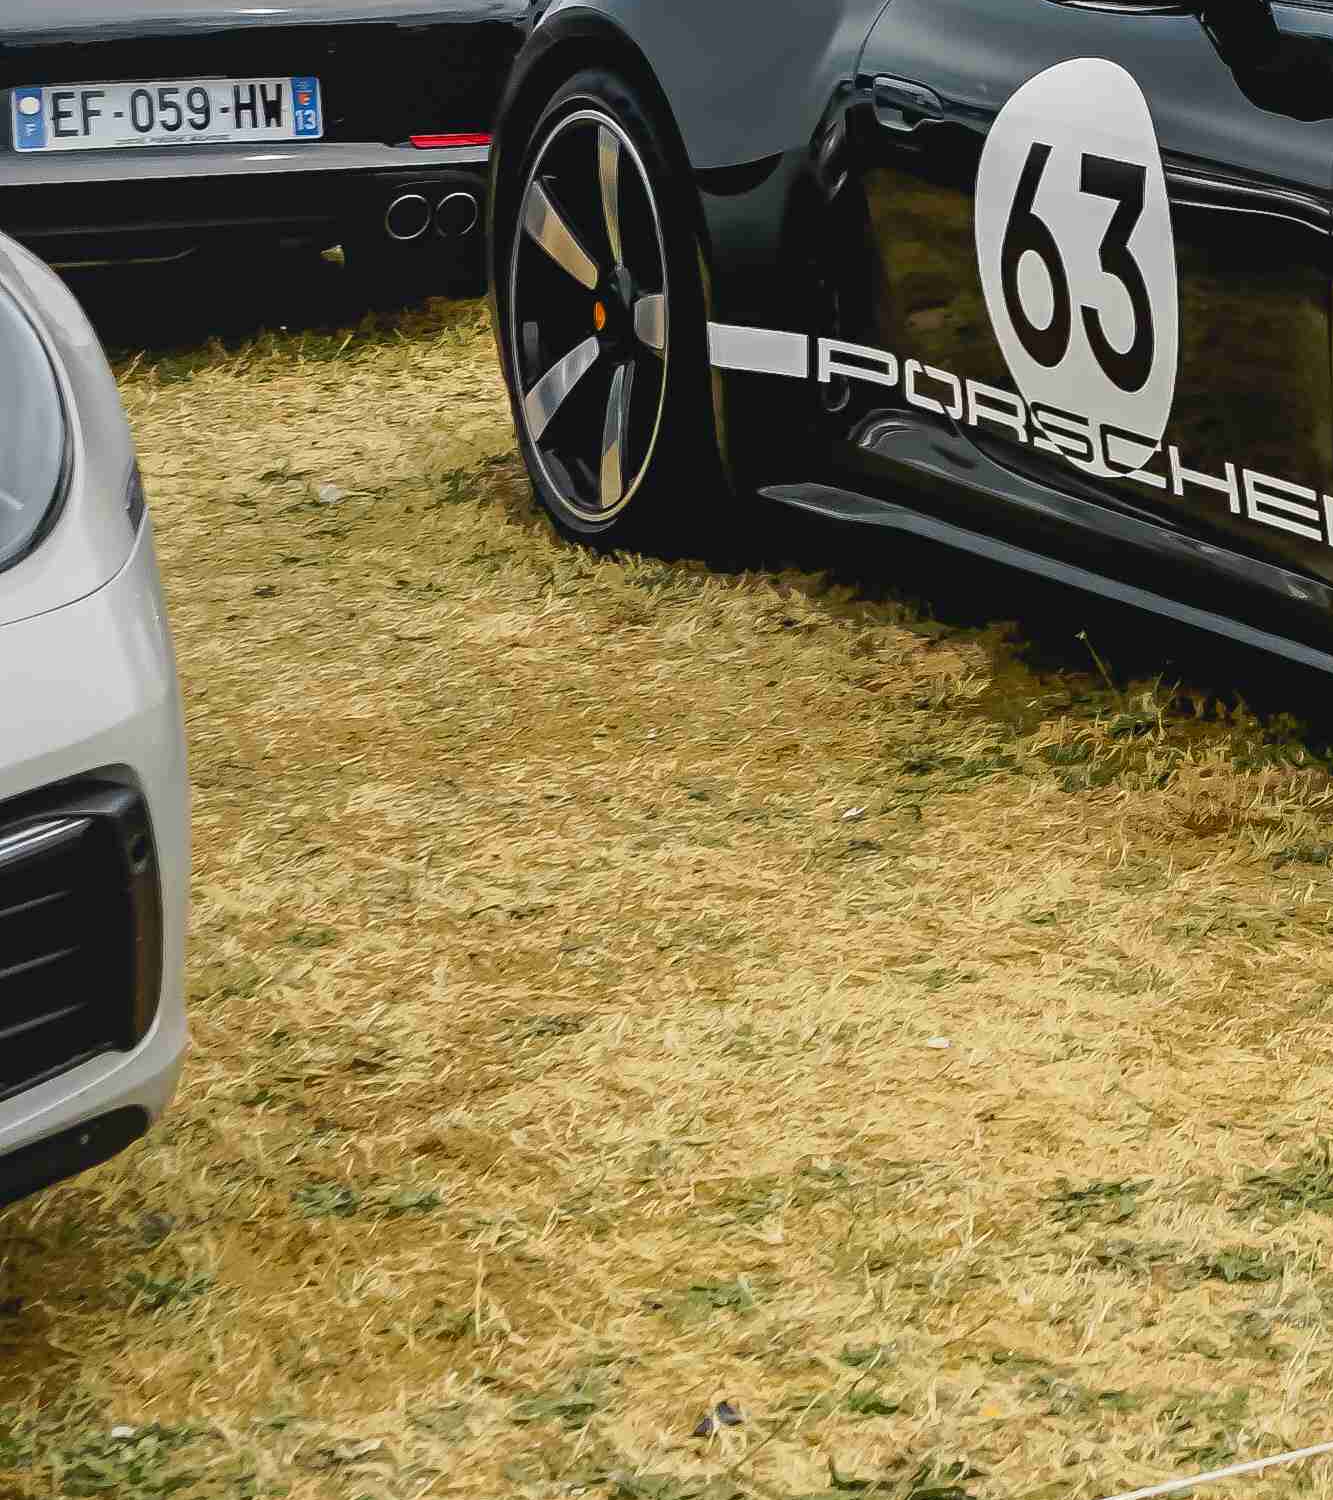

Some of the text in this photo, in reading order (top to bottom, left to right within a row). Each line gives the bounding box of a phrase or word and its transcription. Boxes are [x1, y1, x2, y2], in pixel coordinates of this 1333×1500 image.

[51, 83, 283, 138] EF-059-HW
[295, 109, 316, 130] 13
[1000, 140, 1155, 394] 63
[817, 337, 1322, 542] PORSCHE
